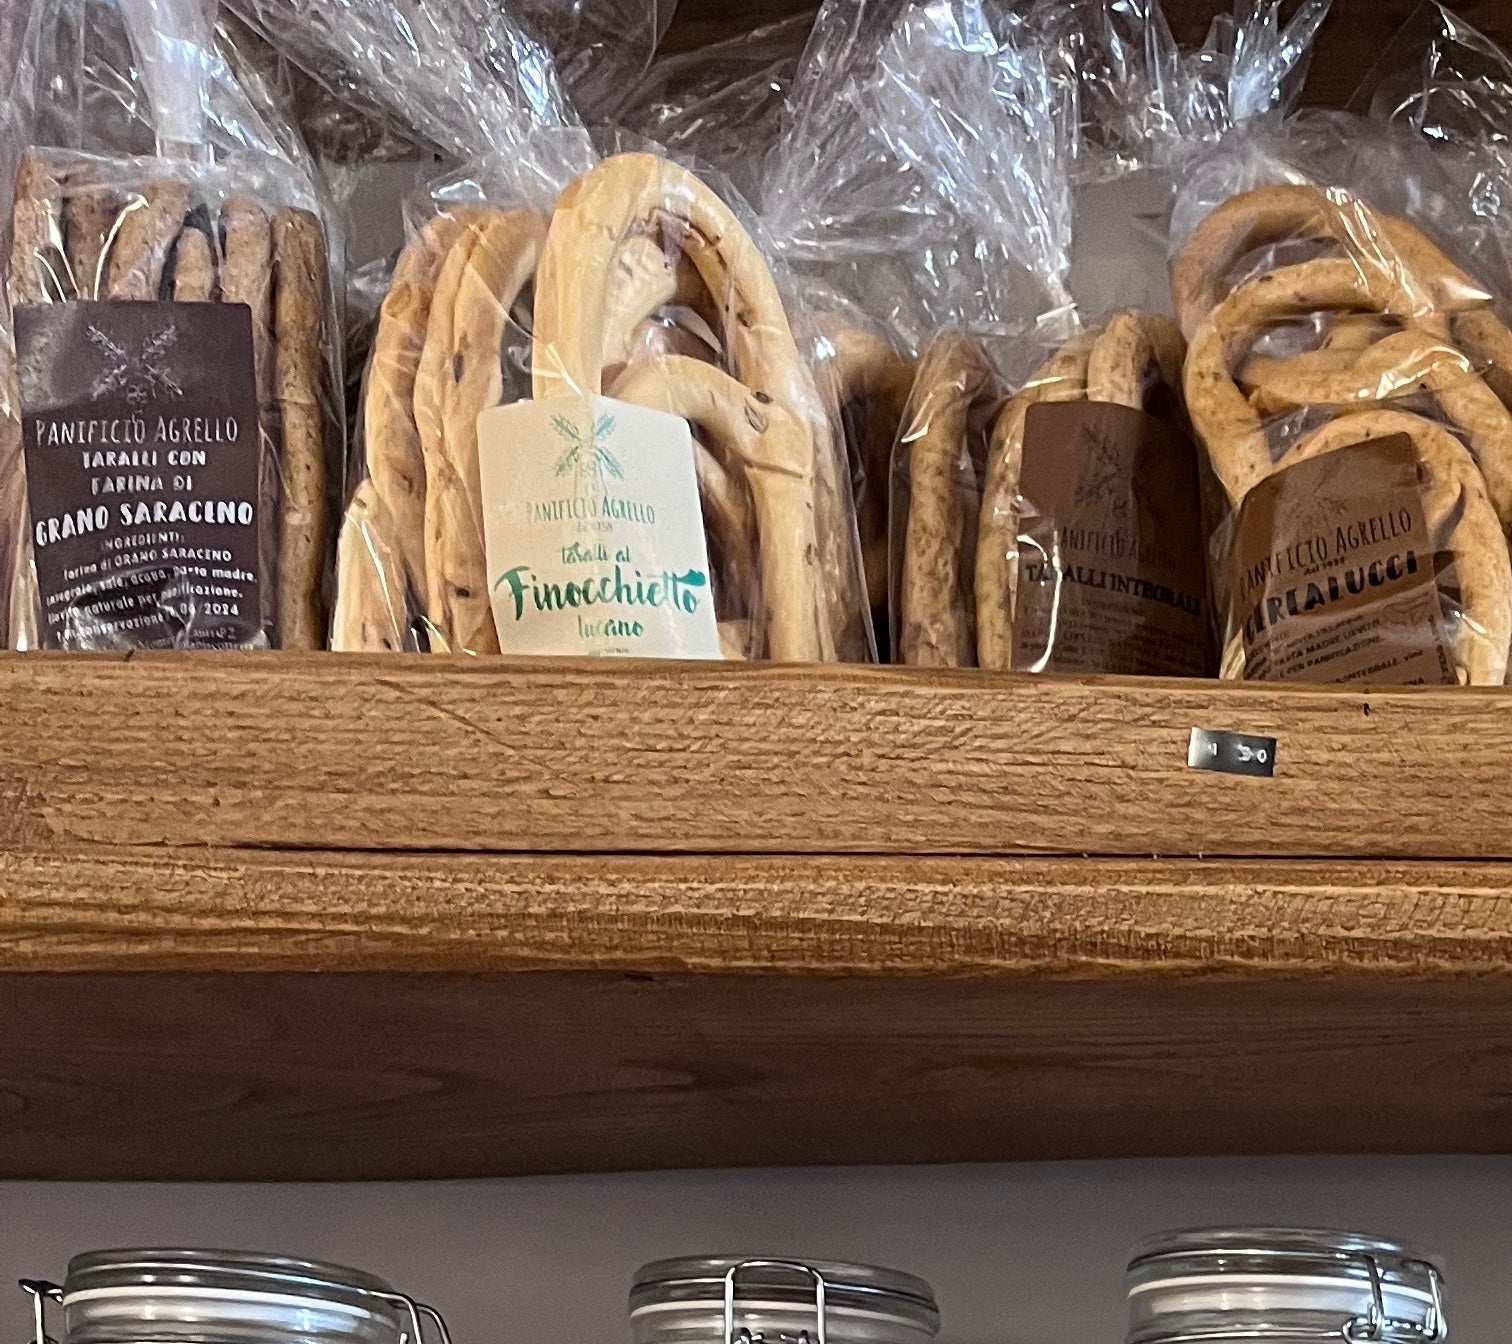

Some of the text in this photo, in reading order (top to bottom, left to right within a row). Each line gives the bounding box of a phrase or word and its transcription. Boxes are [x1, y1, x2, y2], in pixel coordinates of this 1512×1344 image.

[35, 415, 239, 446] PANIFICIO AGRELLO
[82, 450, 206, 468] TARALLI CON
[91, 474, 193, 496] FARINA DI
[35, 500, 254, 547] GRANO SARACENO
[602, 496, 656, 525] AGRELLO
[1335, 507, 1412, 556] AGRELLO
[1026, 563, 1107, 589] TAALLI
[494, 565, 707, 623] Finocchietto
